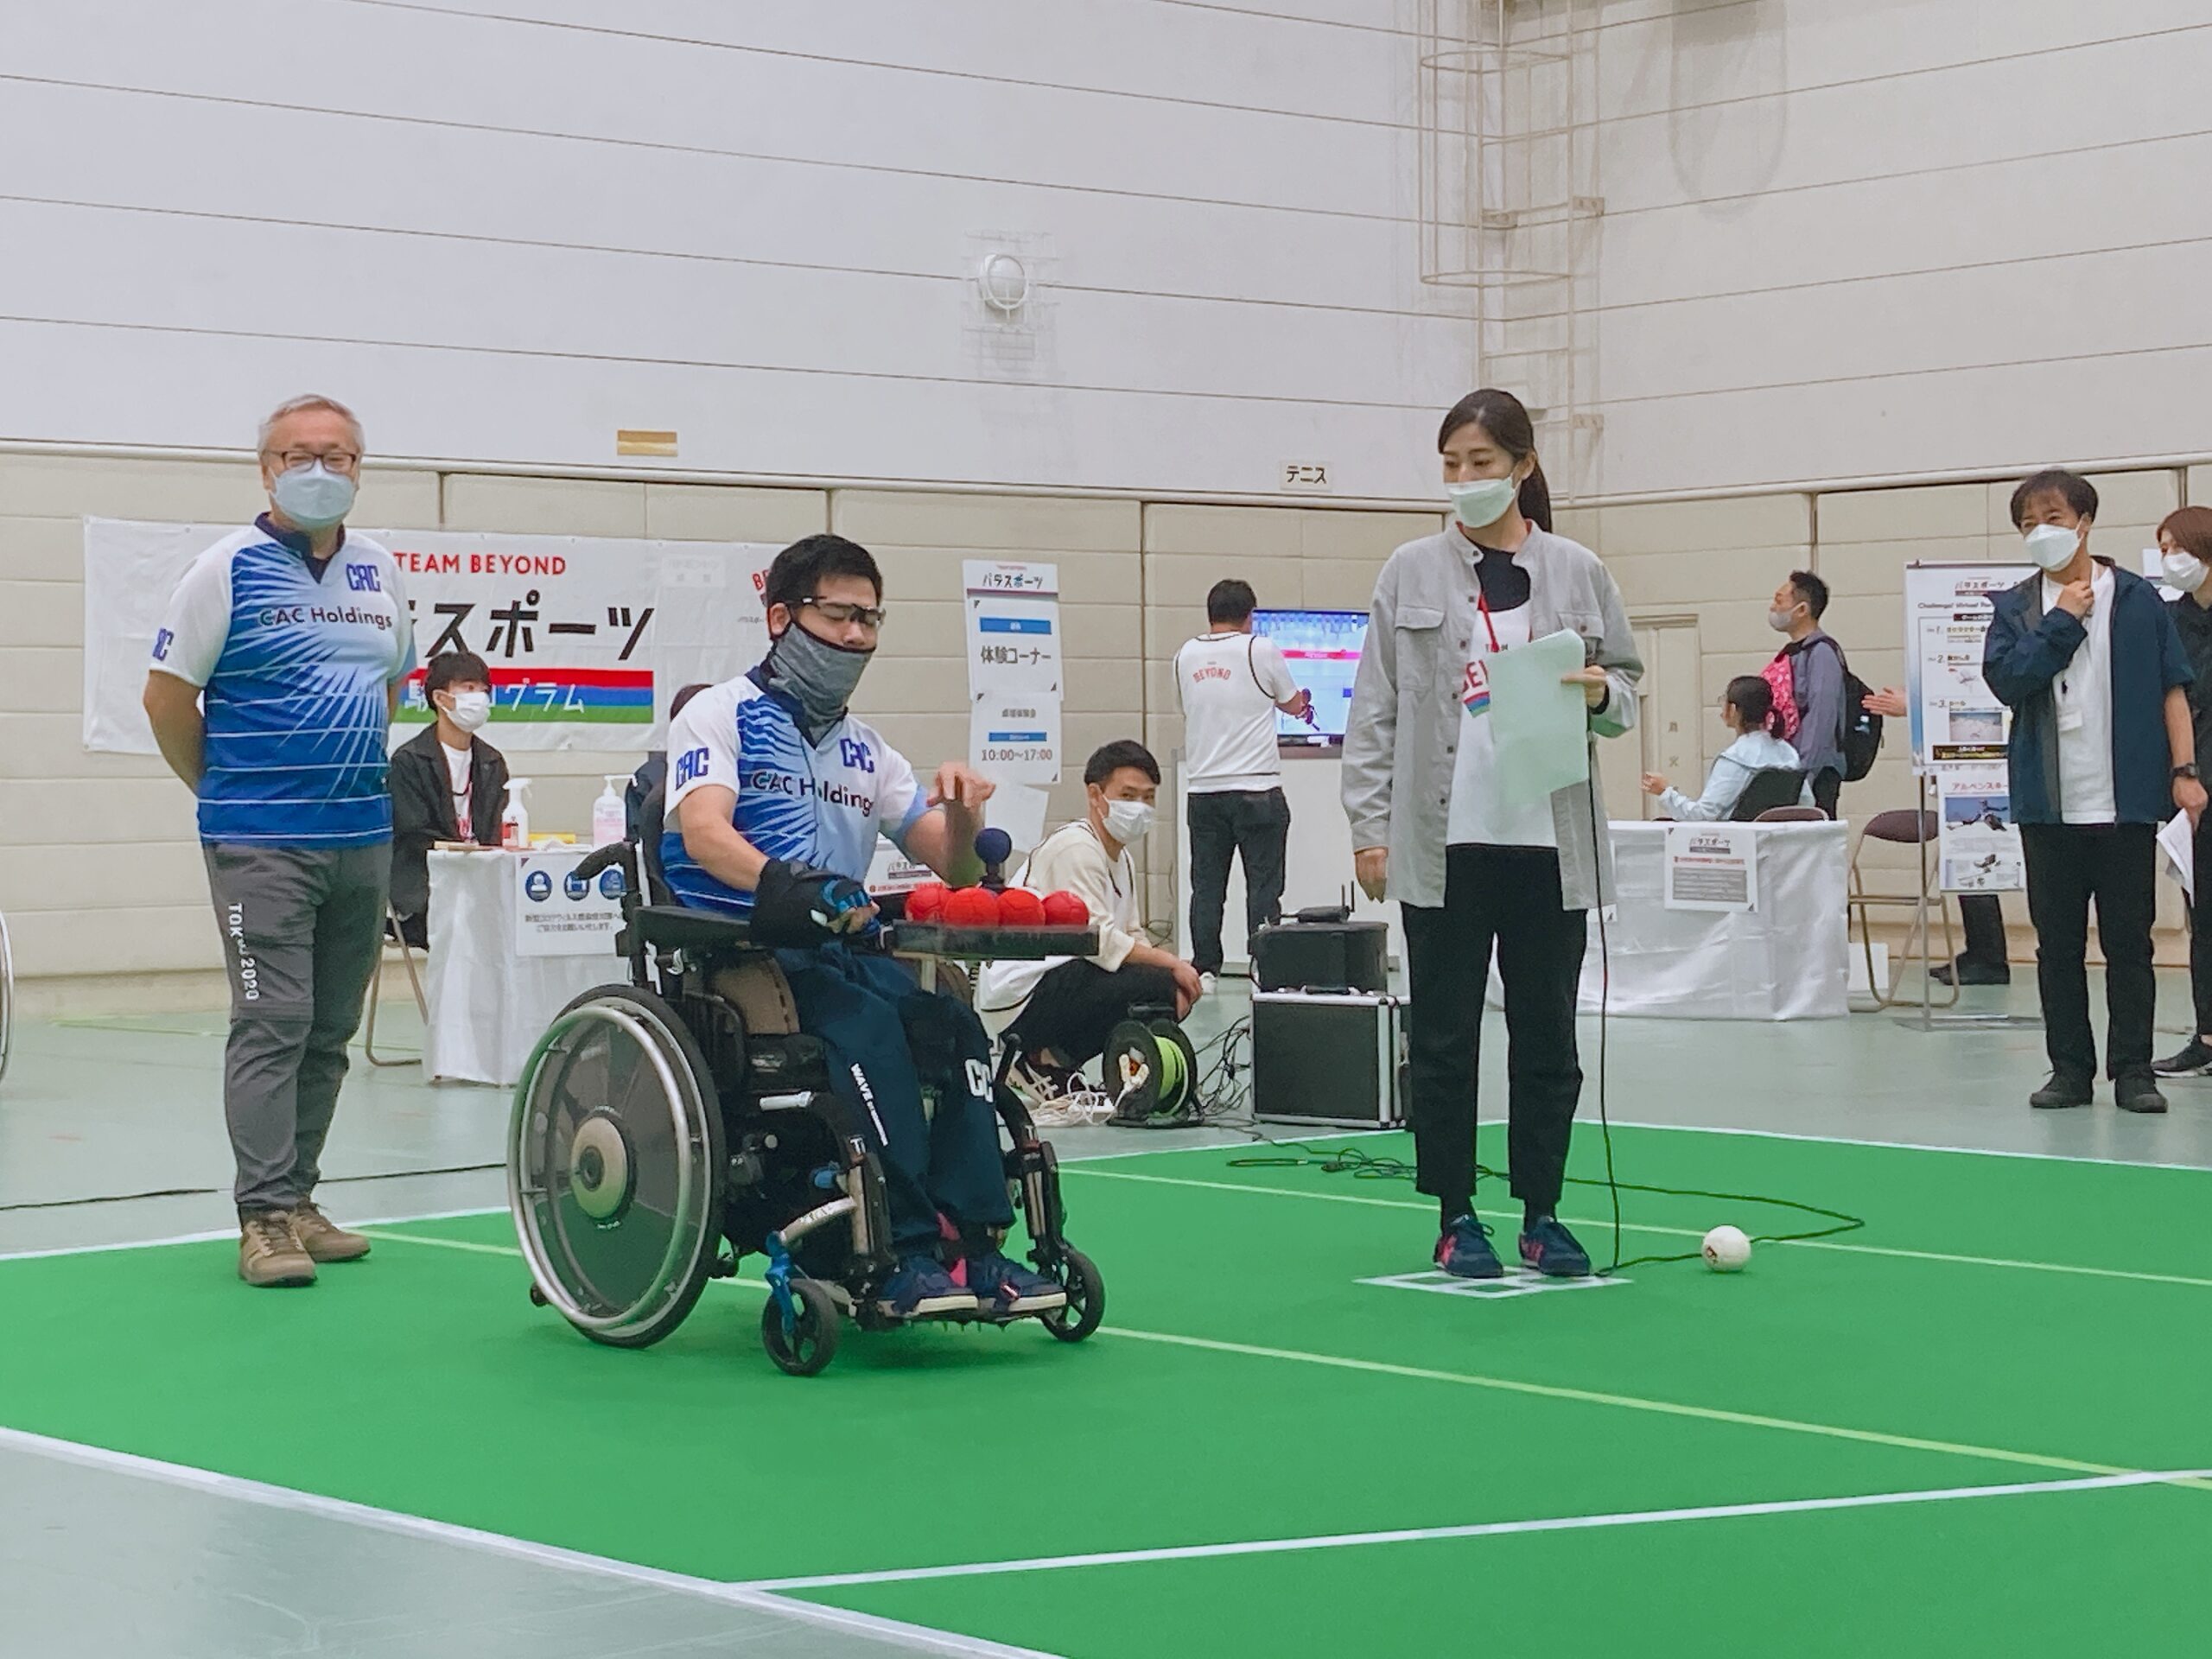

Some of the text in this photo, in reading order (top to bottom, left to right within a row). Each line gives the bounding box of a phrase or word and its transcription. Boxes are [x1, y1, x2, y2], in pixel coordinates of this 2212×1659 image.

[1287, 465, 1327, 484] テニス
[393, 552, 567, 575] TEAM BEYOND
[346, 563, 381, 592] CAC
[259, 606, 392, 631] CAC Holdings
[980, 645, 1052, 665] 体験コーナー
[753, 771, 793, 795] CAC
[240, 957, 260, 1001] 2020
[850, 1063, 874, 1102] WAVE
